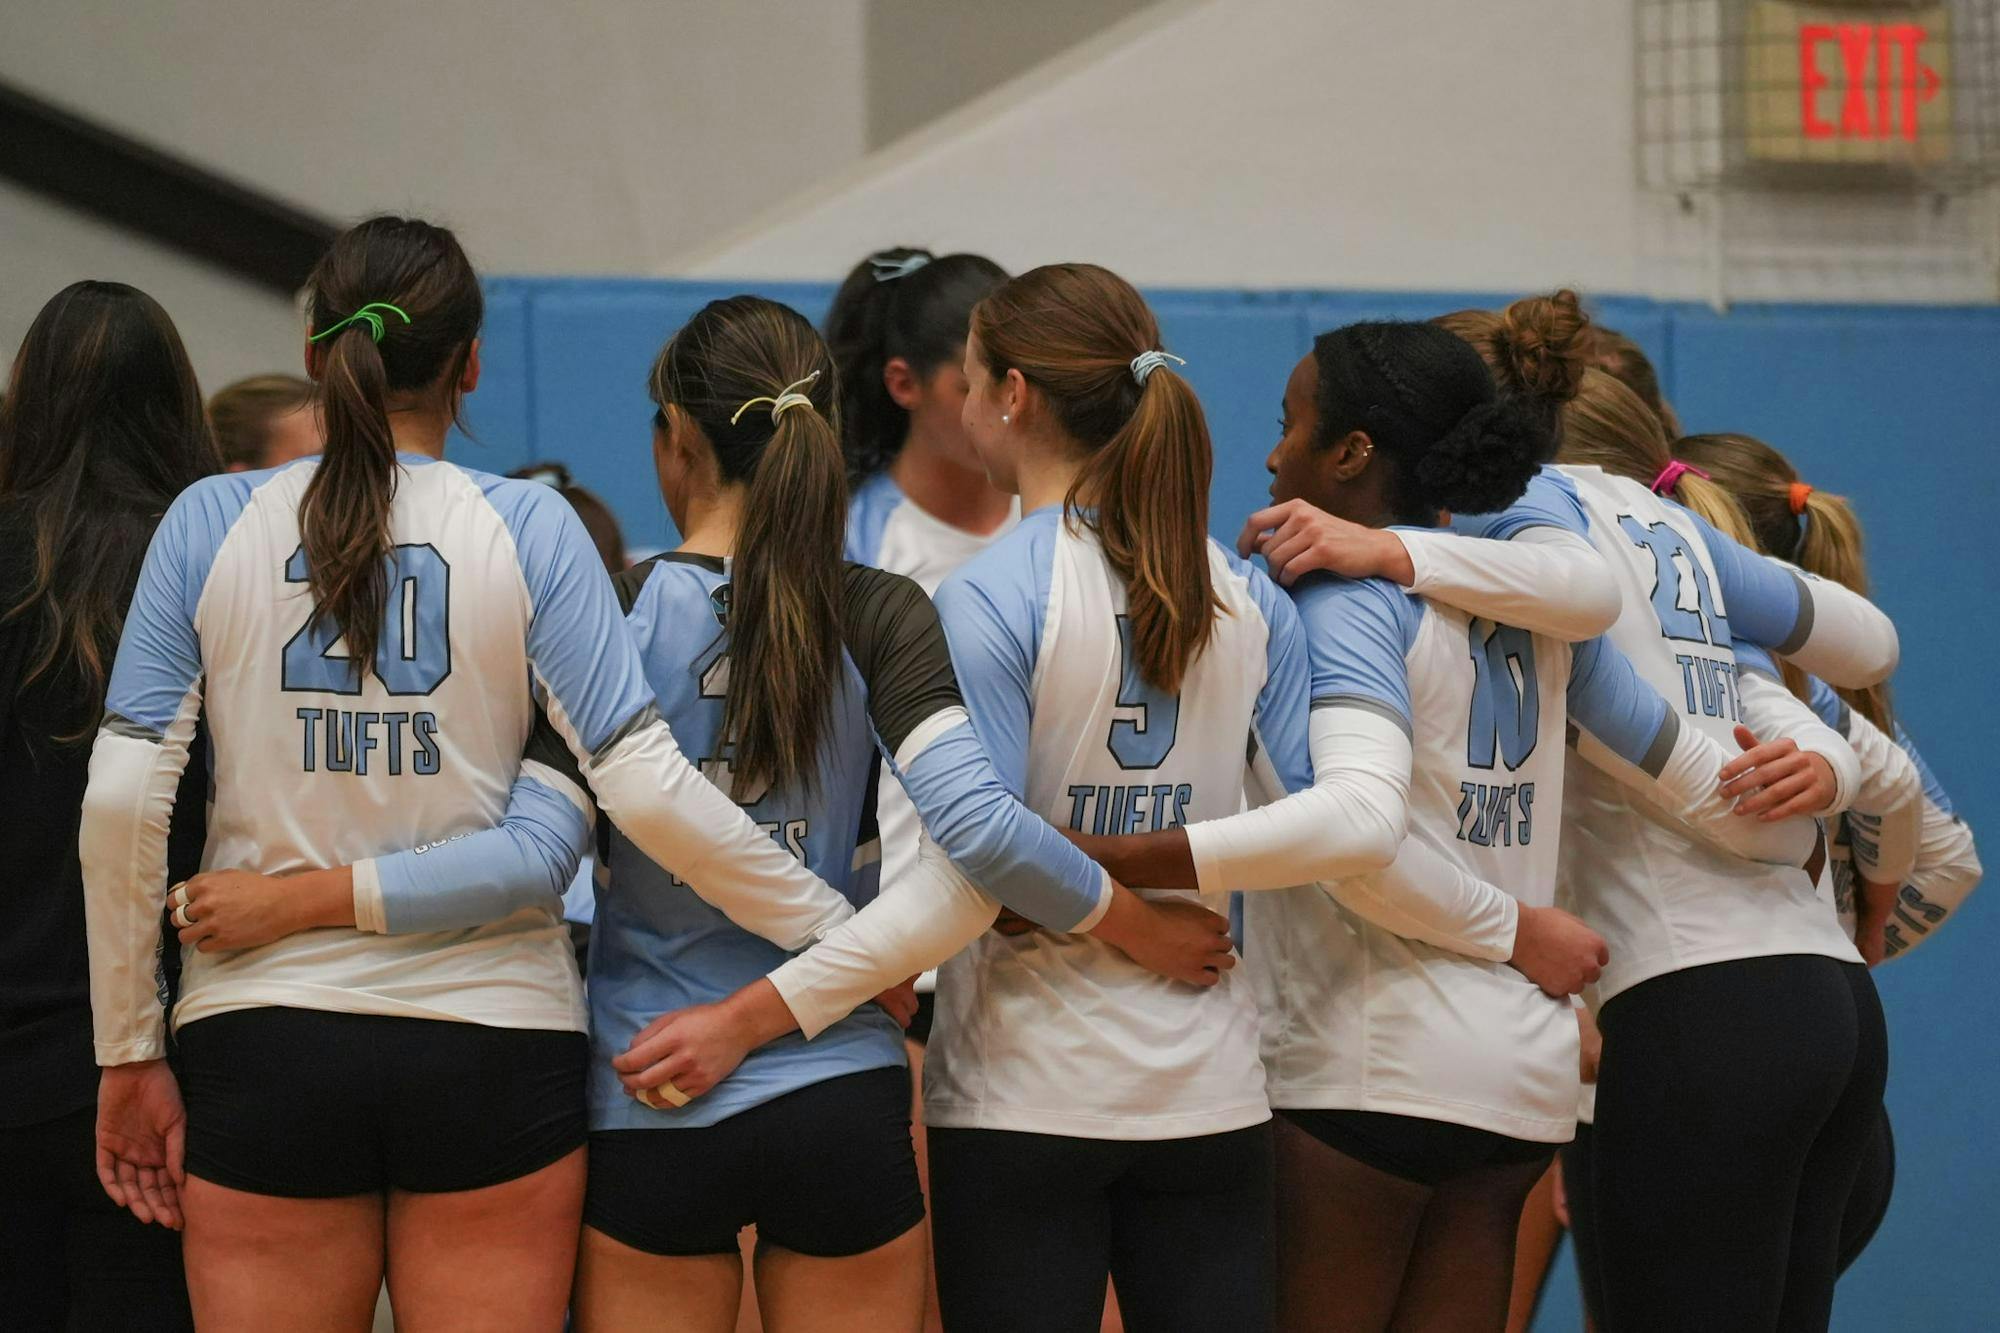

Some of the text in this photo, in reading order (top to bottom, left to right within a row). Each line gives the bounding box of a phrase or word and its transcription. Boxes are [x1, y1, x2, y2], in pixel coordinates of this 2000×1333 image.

[1799, 22, 1928, 142] EXIT
[281, 542, 452, 696] 20
[1106, 614, 1180, 770] 5
[1468, 616, 1540, 771] 10
[296, 707, 441, 776] TUFTS
